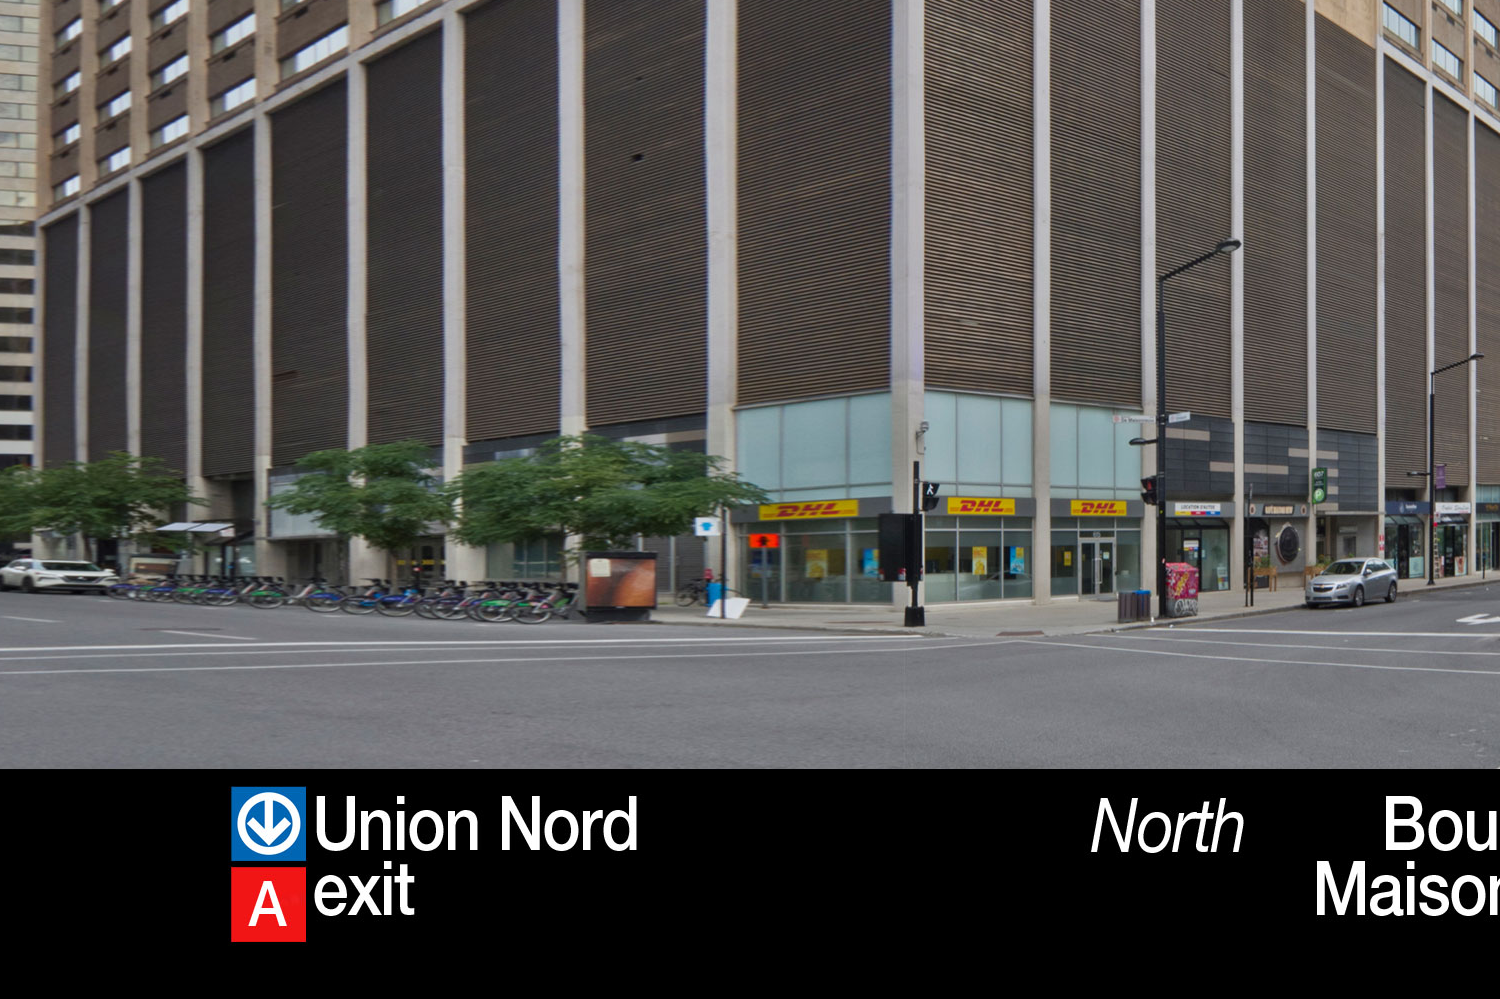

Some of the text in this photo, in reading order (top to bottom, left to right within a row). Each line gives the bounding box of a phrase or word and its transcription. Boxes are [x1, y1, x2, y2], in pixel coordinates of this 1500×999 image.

[776, 502, 840, 517] DHL
[960, 500, 1004, 513] DHL
[1081, 502, 1117, 514] DHL
